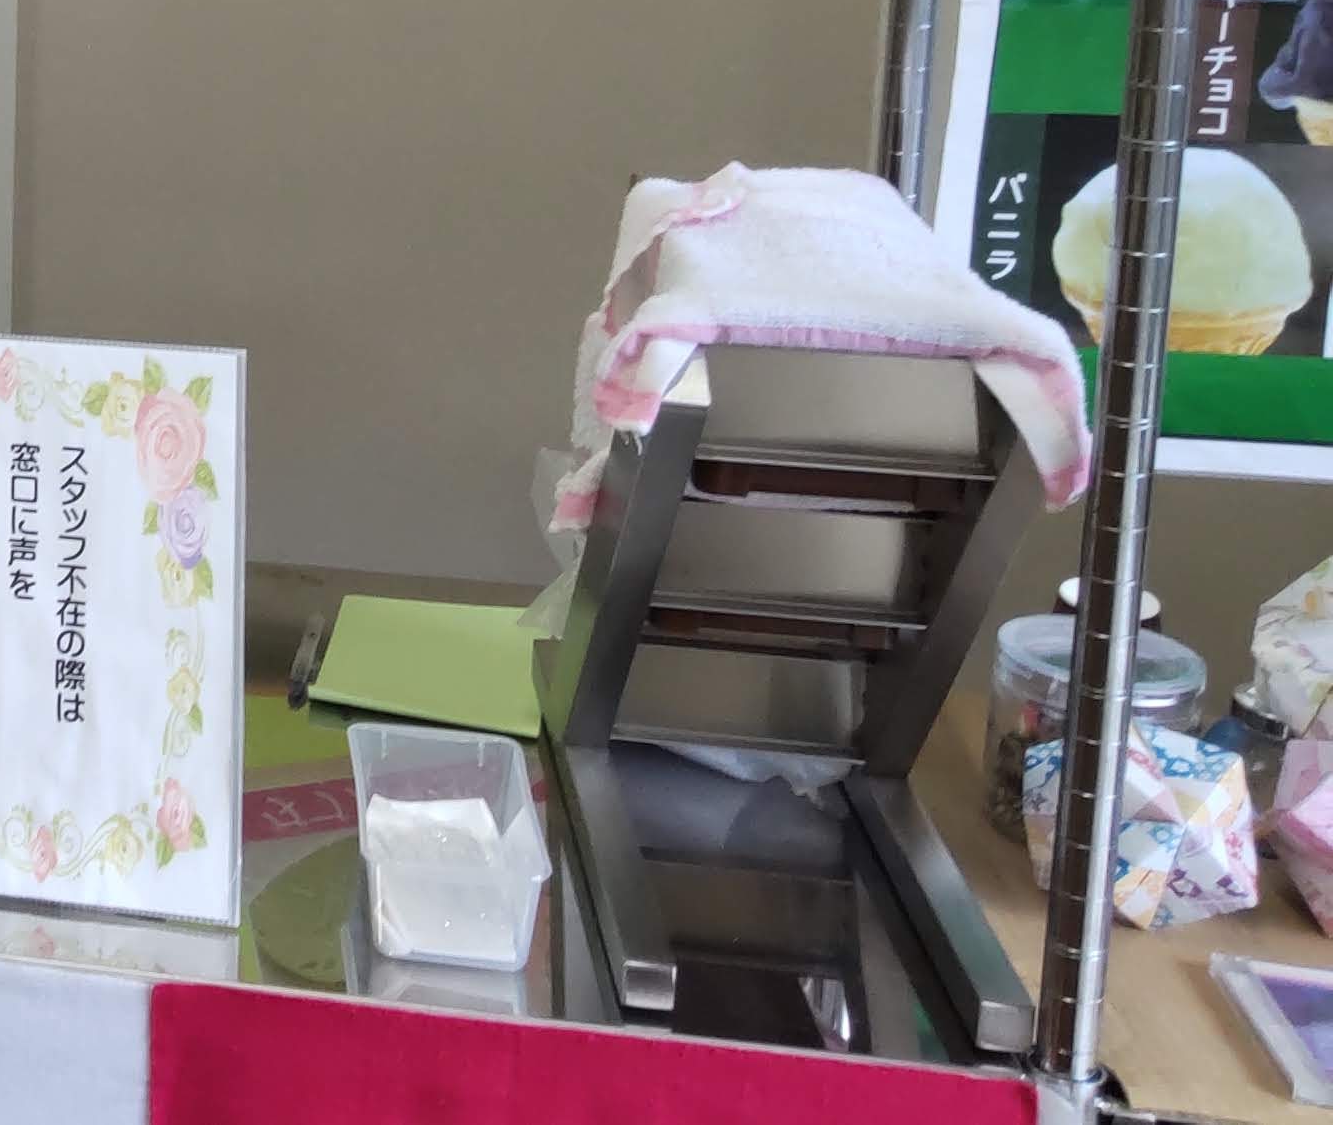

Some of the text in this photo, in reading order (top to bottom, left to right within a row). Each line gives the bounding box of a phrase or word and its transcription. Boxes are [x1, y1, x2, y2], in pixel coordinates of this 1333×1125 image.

[985, 172, 1028, 281] バニラ
[6, 441, 41, 601] 窓口に声を
[53, 444, 90, 724] スタッフ不在の際は
